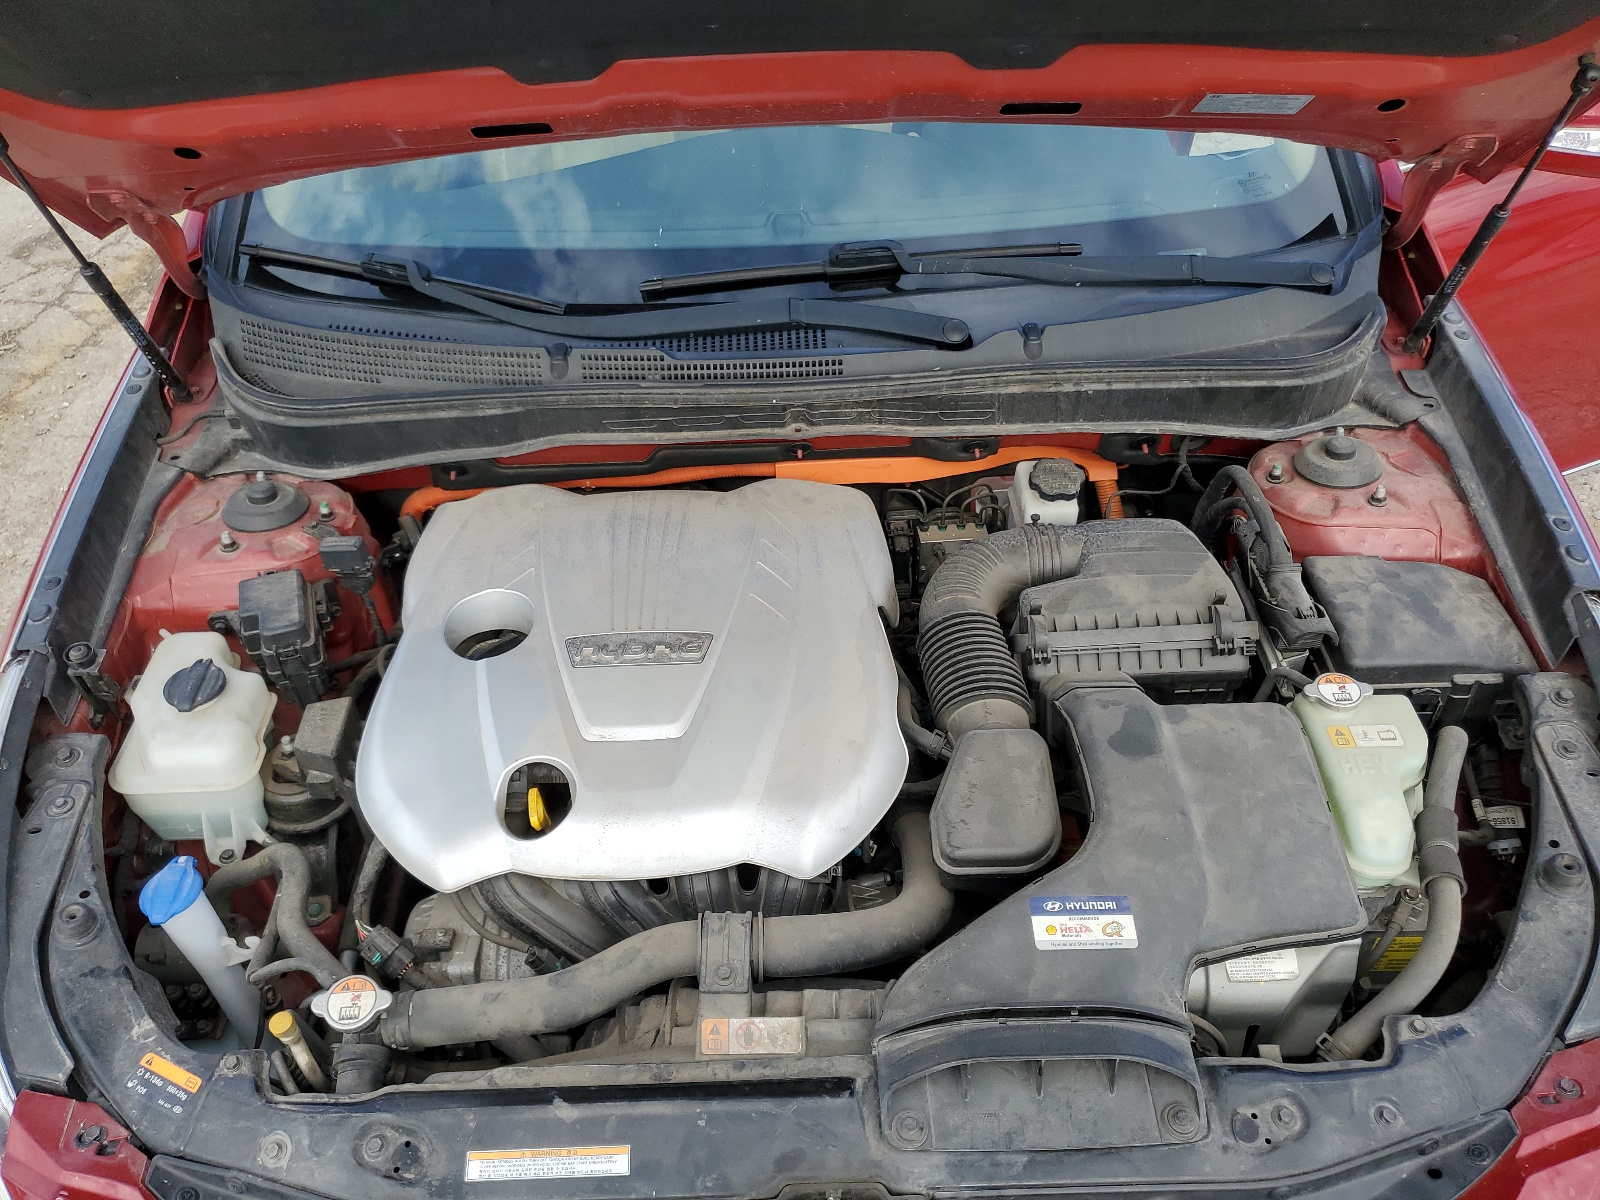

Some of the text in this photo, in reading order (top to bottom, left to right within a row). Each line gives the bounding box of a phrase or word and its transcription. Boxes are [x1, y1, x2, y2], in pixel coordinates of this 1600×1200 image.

[1066, 901, 1117, 910] HYUNDAI
[1059, 925, 1093, 934] HELIX
[530, 1149, 562, 1158] WARNING
